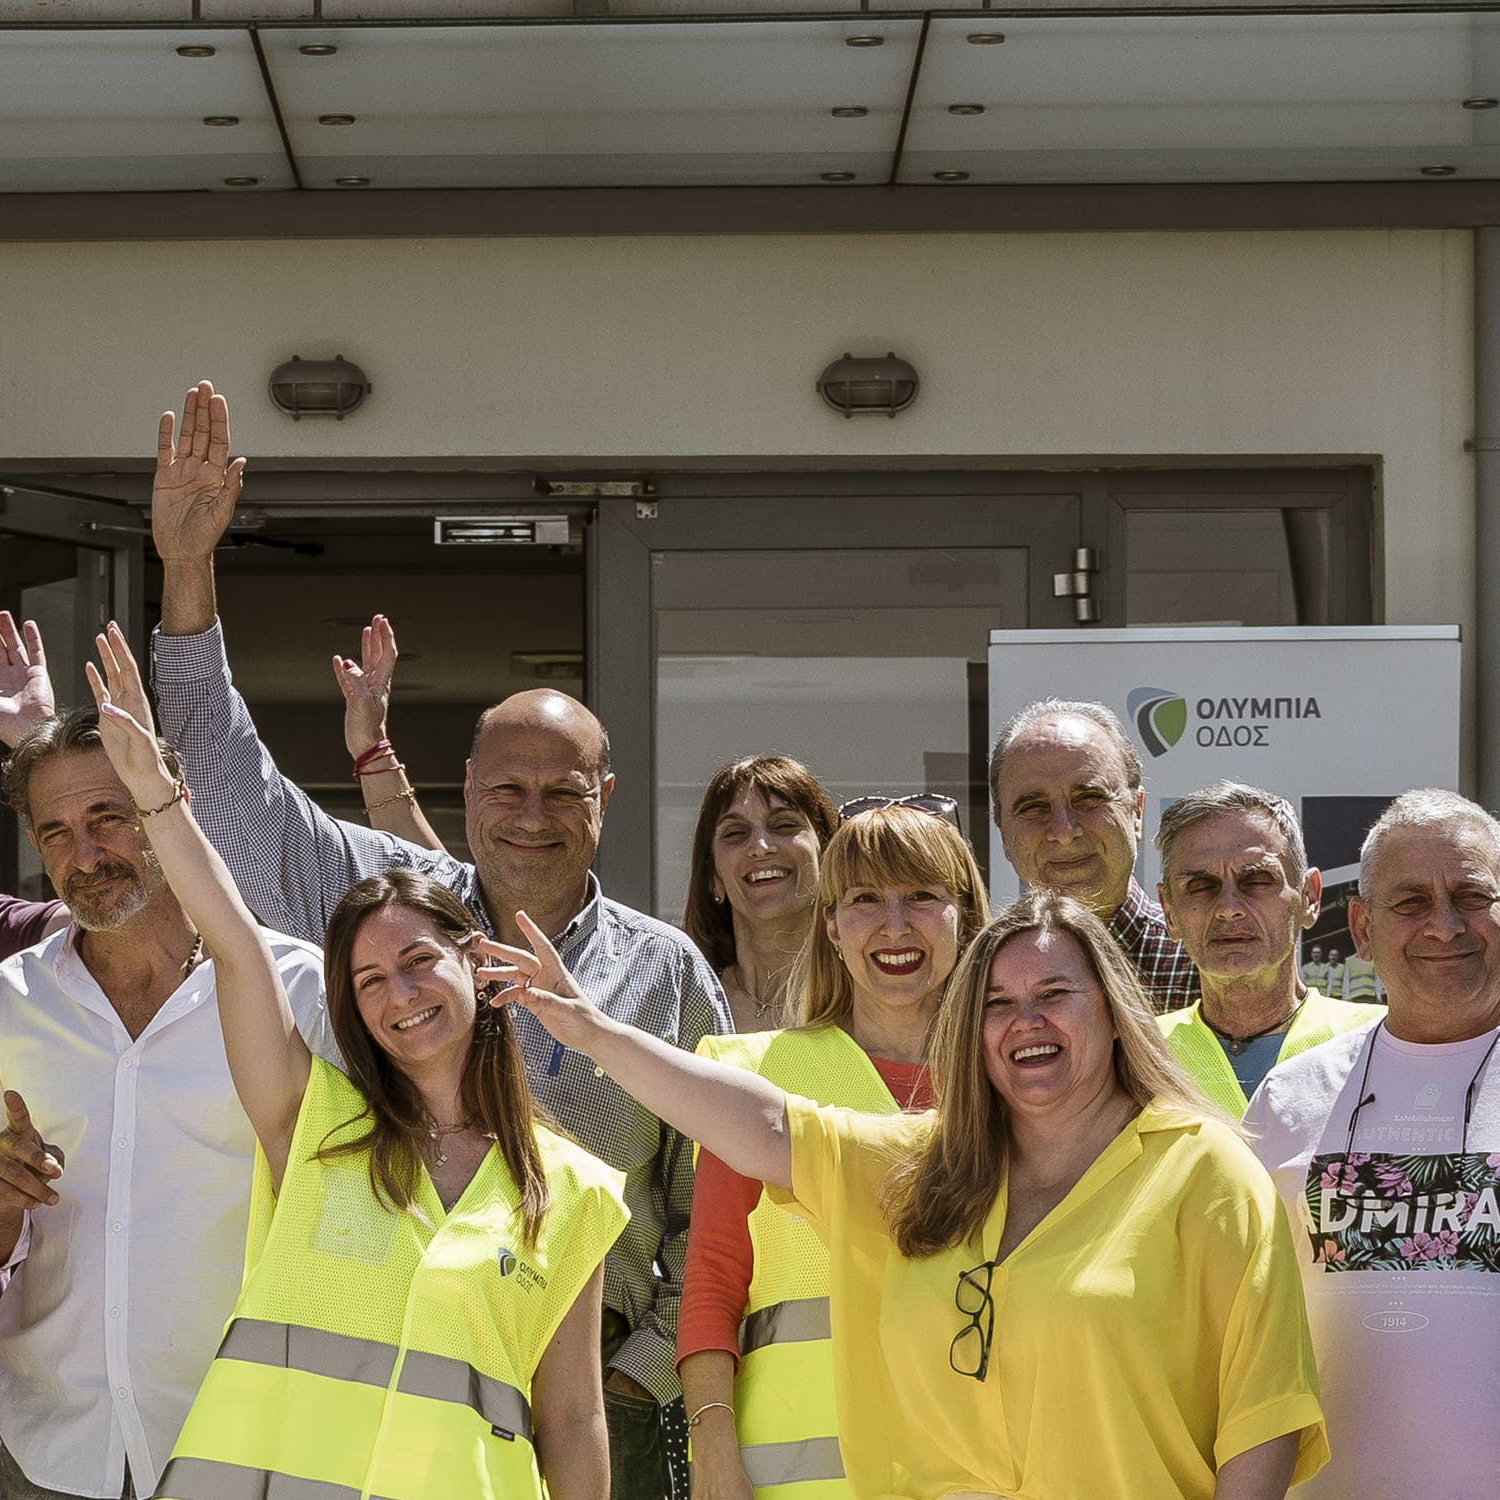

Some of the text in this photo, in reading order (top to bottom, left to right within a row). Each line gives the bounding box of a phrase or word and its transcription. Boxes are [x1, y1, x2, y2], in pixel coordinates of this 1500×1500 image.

[1195, 697, 1321, 720] ΟΛΥΜΠΙΑ
[1195, 725, 1269, 748] ΟΔΟΣ
[1381, 1317, 1408, 1328] 1914
